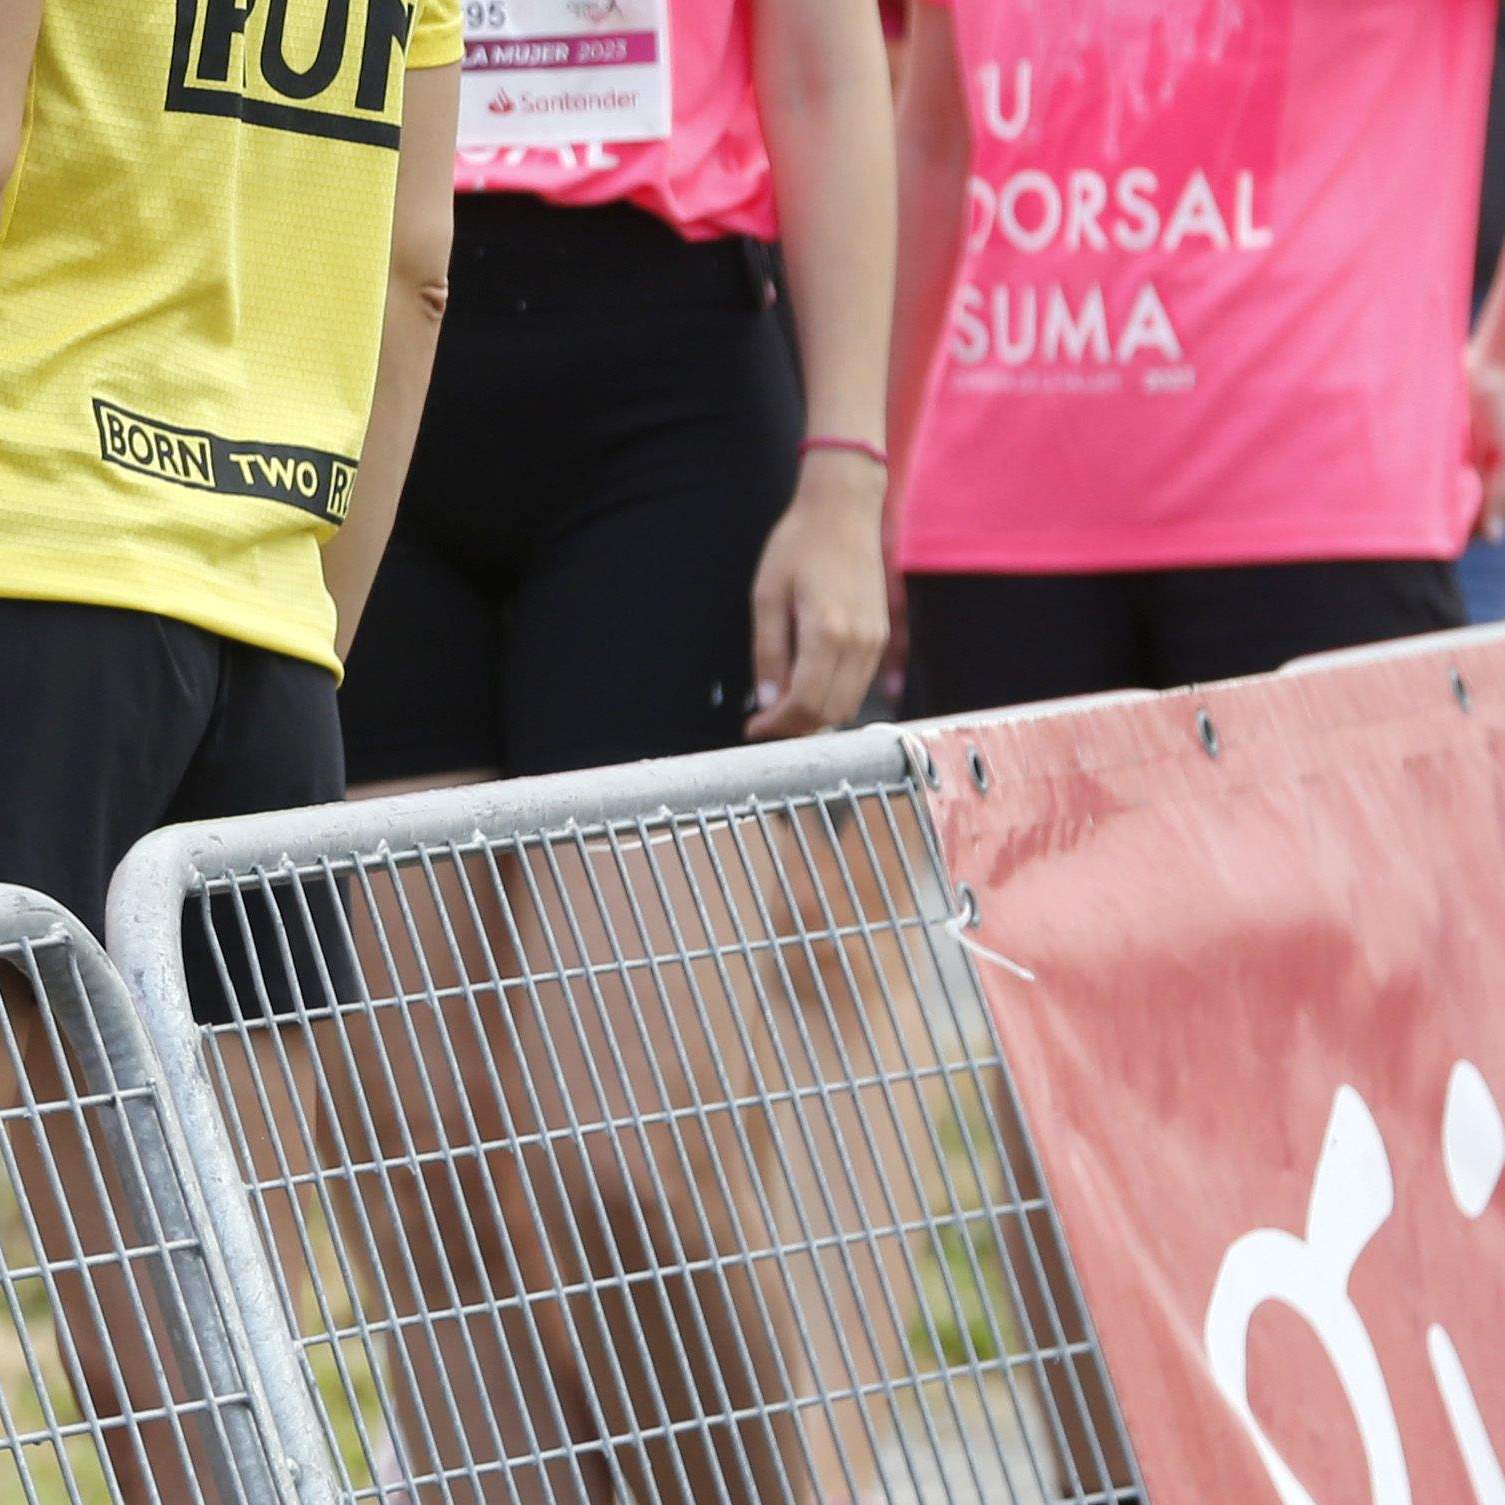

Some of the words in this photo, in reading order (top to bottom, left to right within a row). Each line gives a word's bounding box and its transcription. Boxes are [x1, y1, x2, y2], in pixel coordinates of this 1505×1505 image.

[466, 0, 506, 29] 95
[979, 62, 1031, 139] U
[949, 283, 1183, 364] SUMA
[107, 413, 210, 482] BORN
[229, 453, 319, 498] TWO
